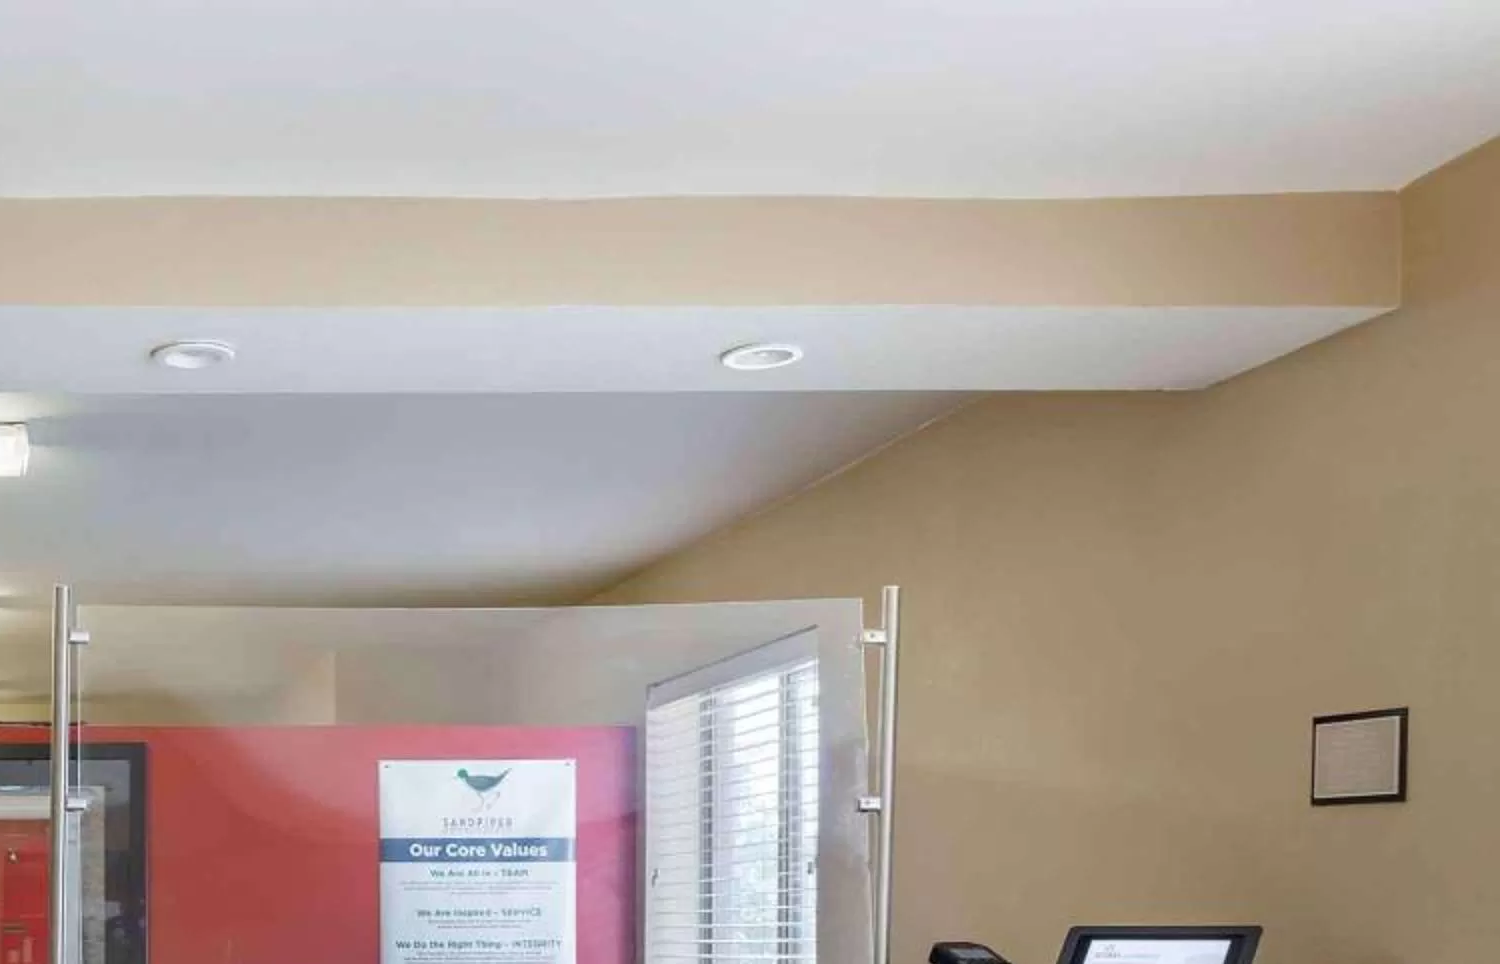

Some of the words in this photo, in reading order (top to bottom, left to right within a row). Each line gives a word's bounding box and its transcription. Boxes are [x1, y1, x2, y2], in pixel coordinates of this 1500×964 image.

[409, 843, 441, 857] Our
[446, 843, 485, 857] Core
[491, 843, 549, 857] Values
[429, 869, 445, 877] We
[396, 940, 411, 949] We
